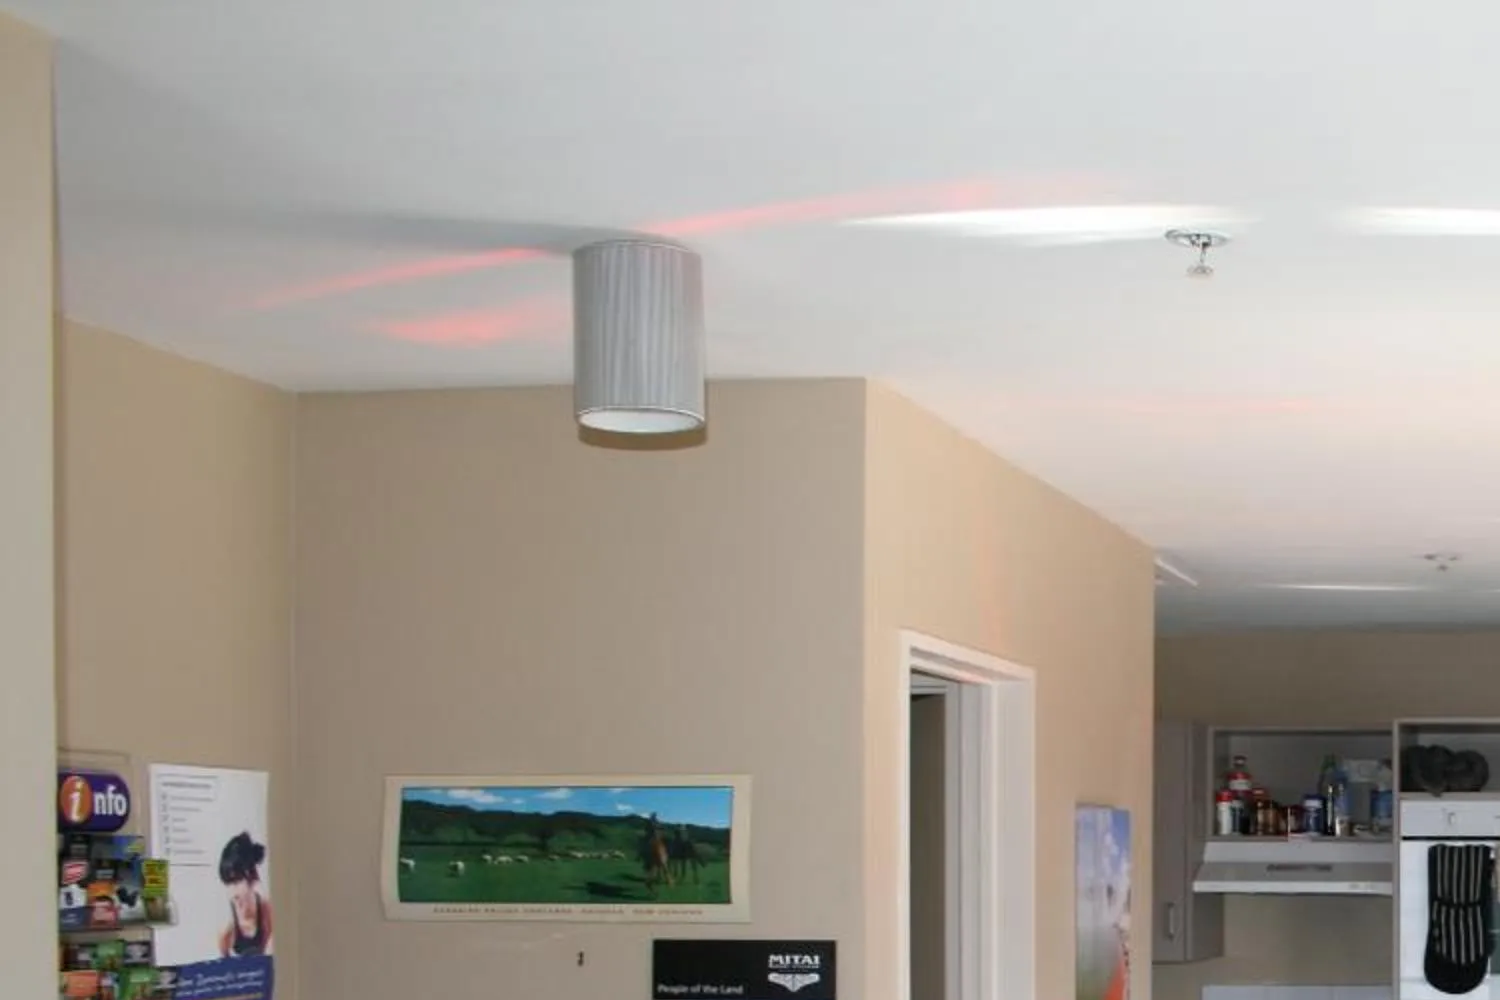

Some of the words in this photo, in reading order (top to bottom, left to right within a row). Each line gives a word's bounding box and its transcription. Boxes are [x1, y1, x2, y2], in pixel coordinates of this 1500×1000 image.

[69, 777, 128, 822] info
[768, 954, 820, 967] MITAI
[657, 984, 688, 995] People
[690, 983, 701, 993] of
[702, 984, 718, 993] the
[720, 985, 744, 995] Land
